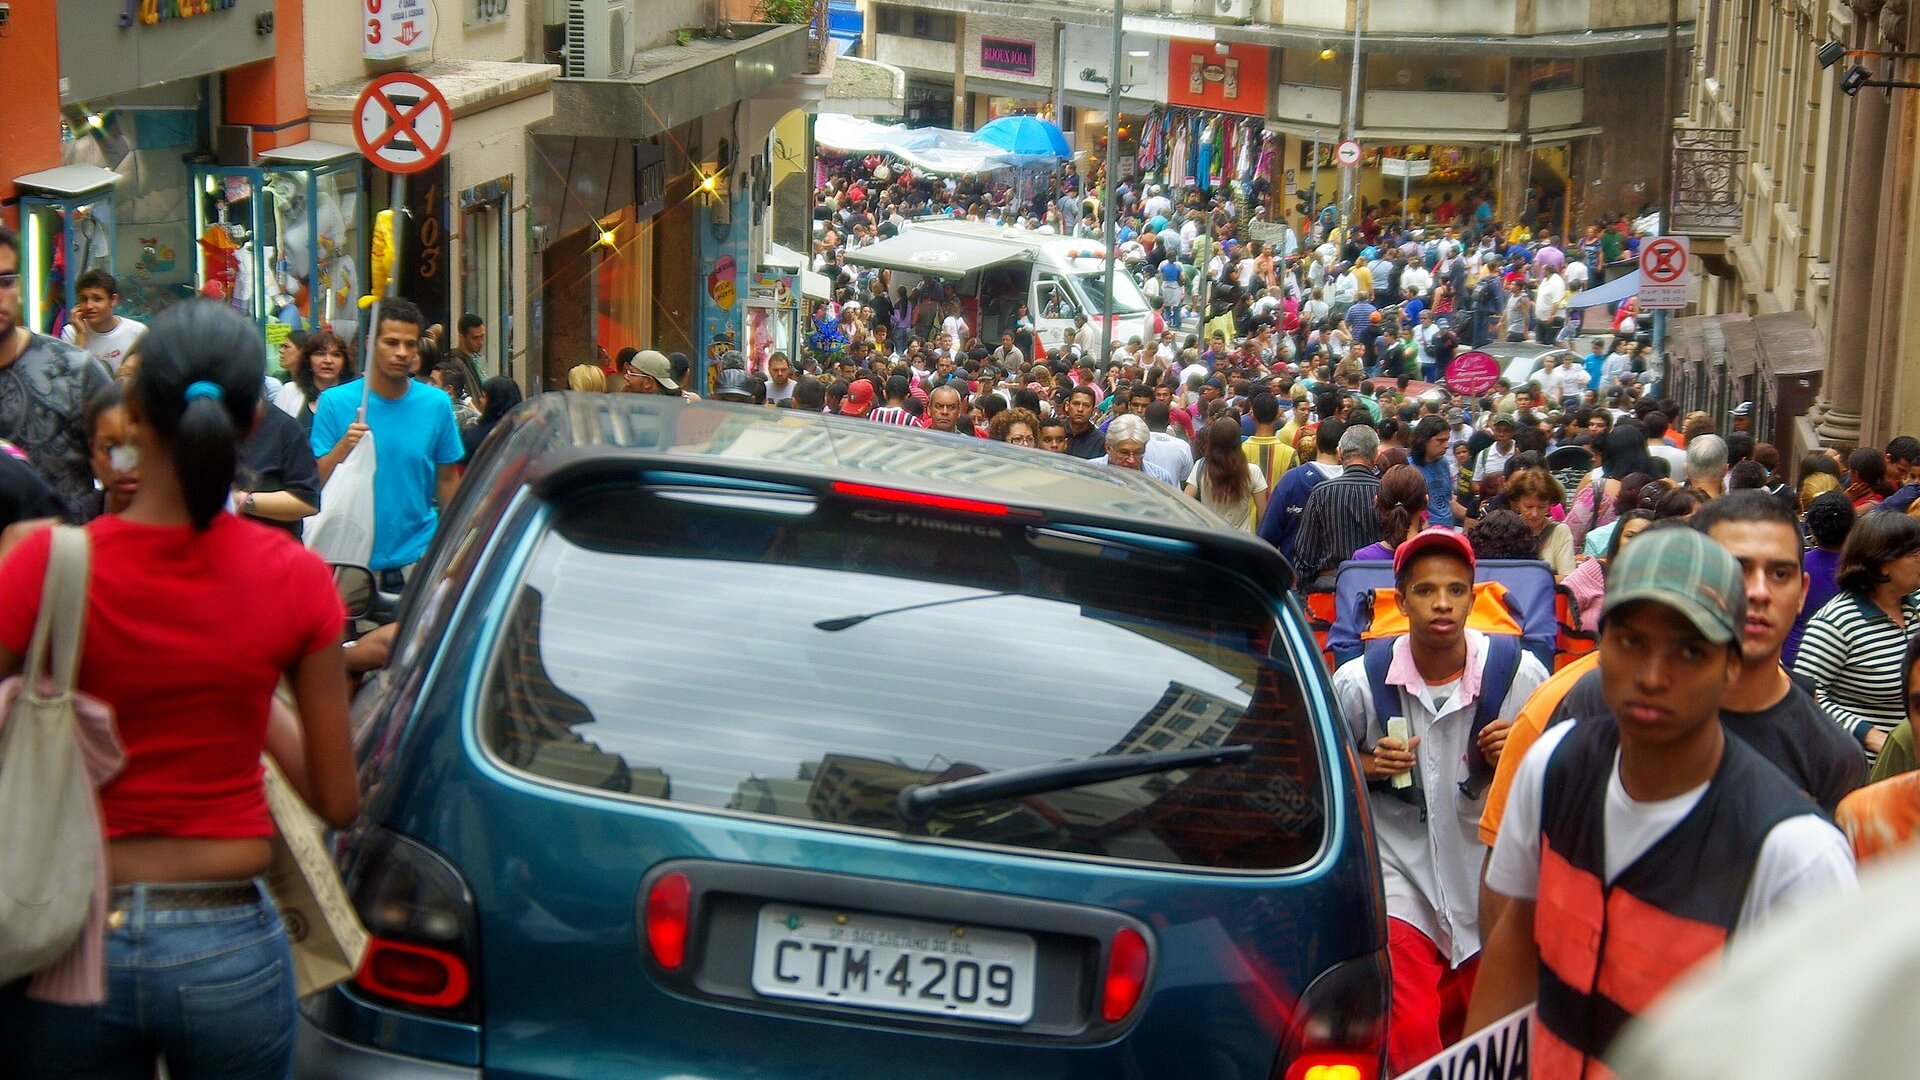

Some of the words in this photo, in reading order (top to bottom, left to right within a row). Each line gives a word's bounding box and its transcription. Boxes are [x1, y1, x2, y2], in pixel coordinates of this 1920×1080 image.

[984, 47, 1010, 62] BIJOUX
[1011, 48, 1028, 65] JÓIA
[420, 183, 440, 278] 103
[896, 512, 1003, 539] Primarca
[951, 940, 973, 955] SUL
[1425, 1015, 1529, 1080] ONA
